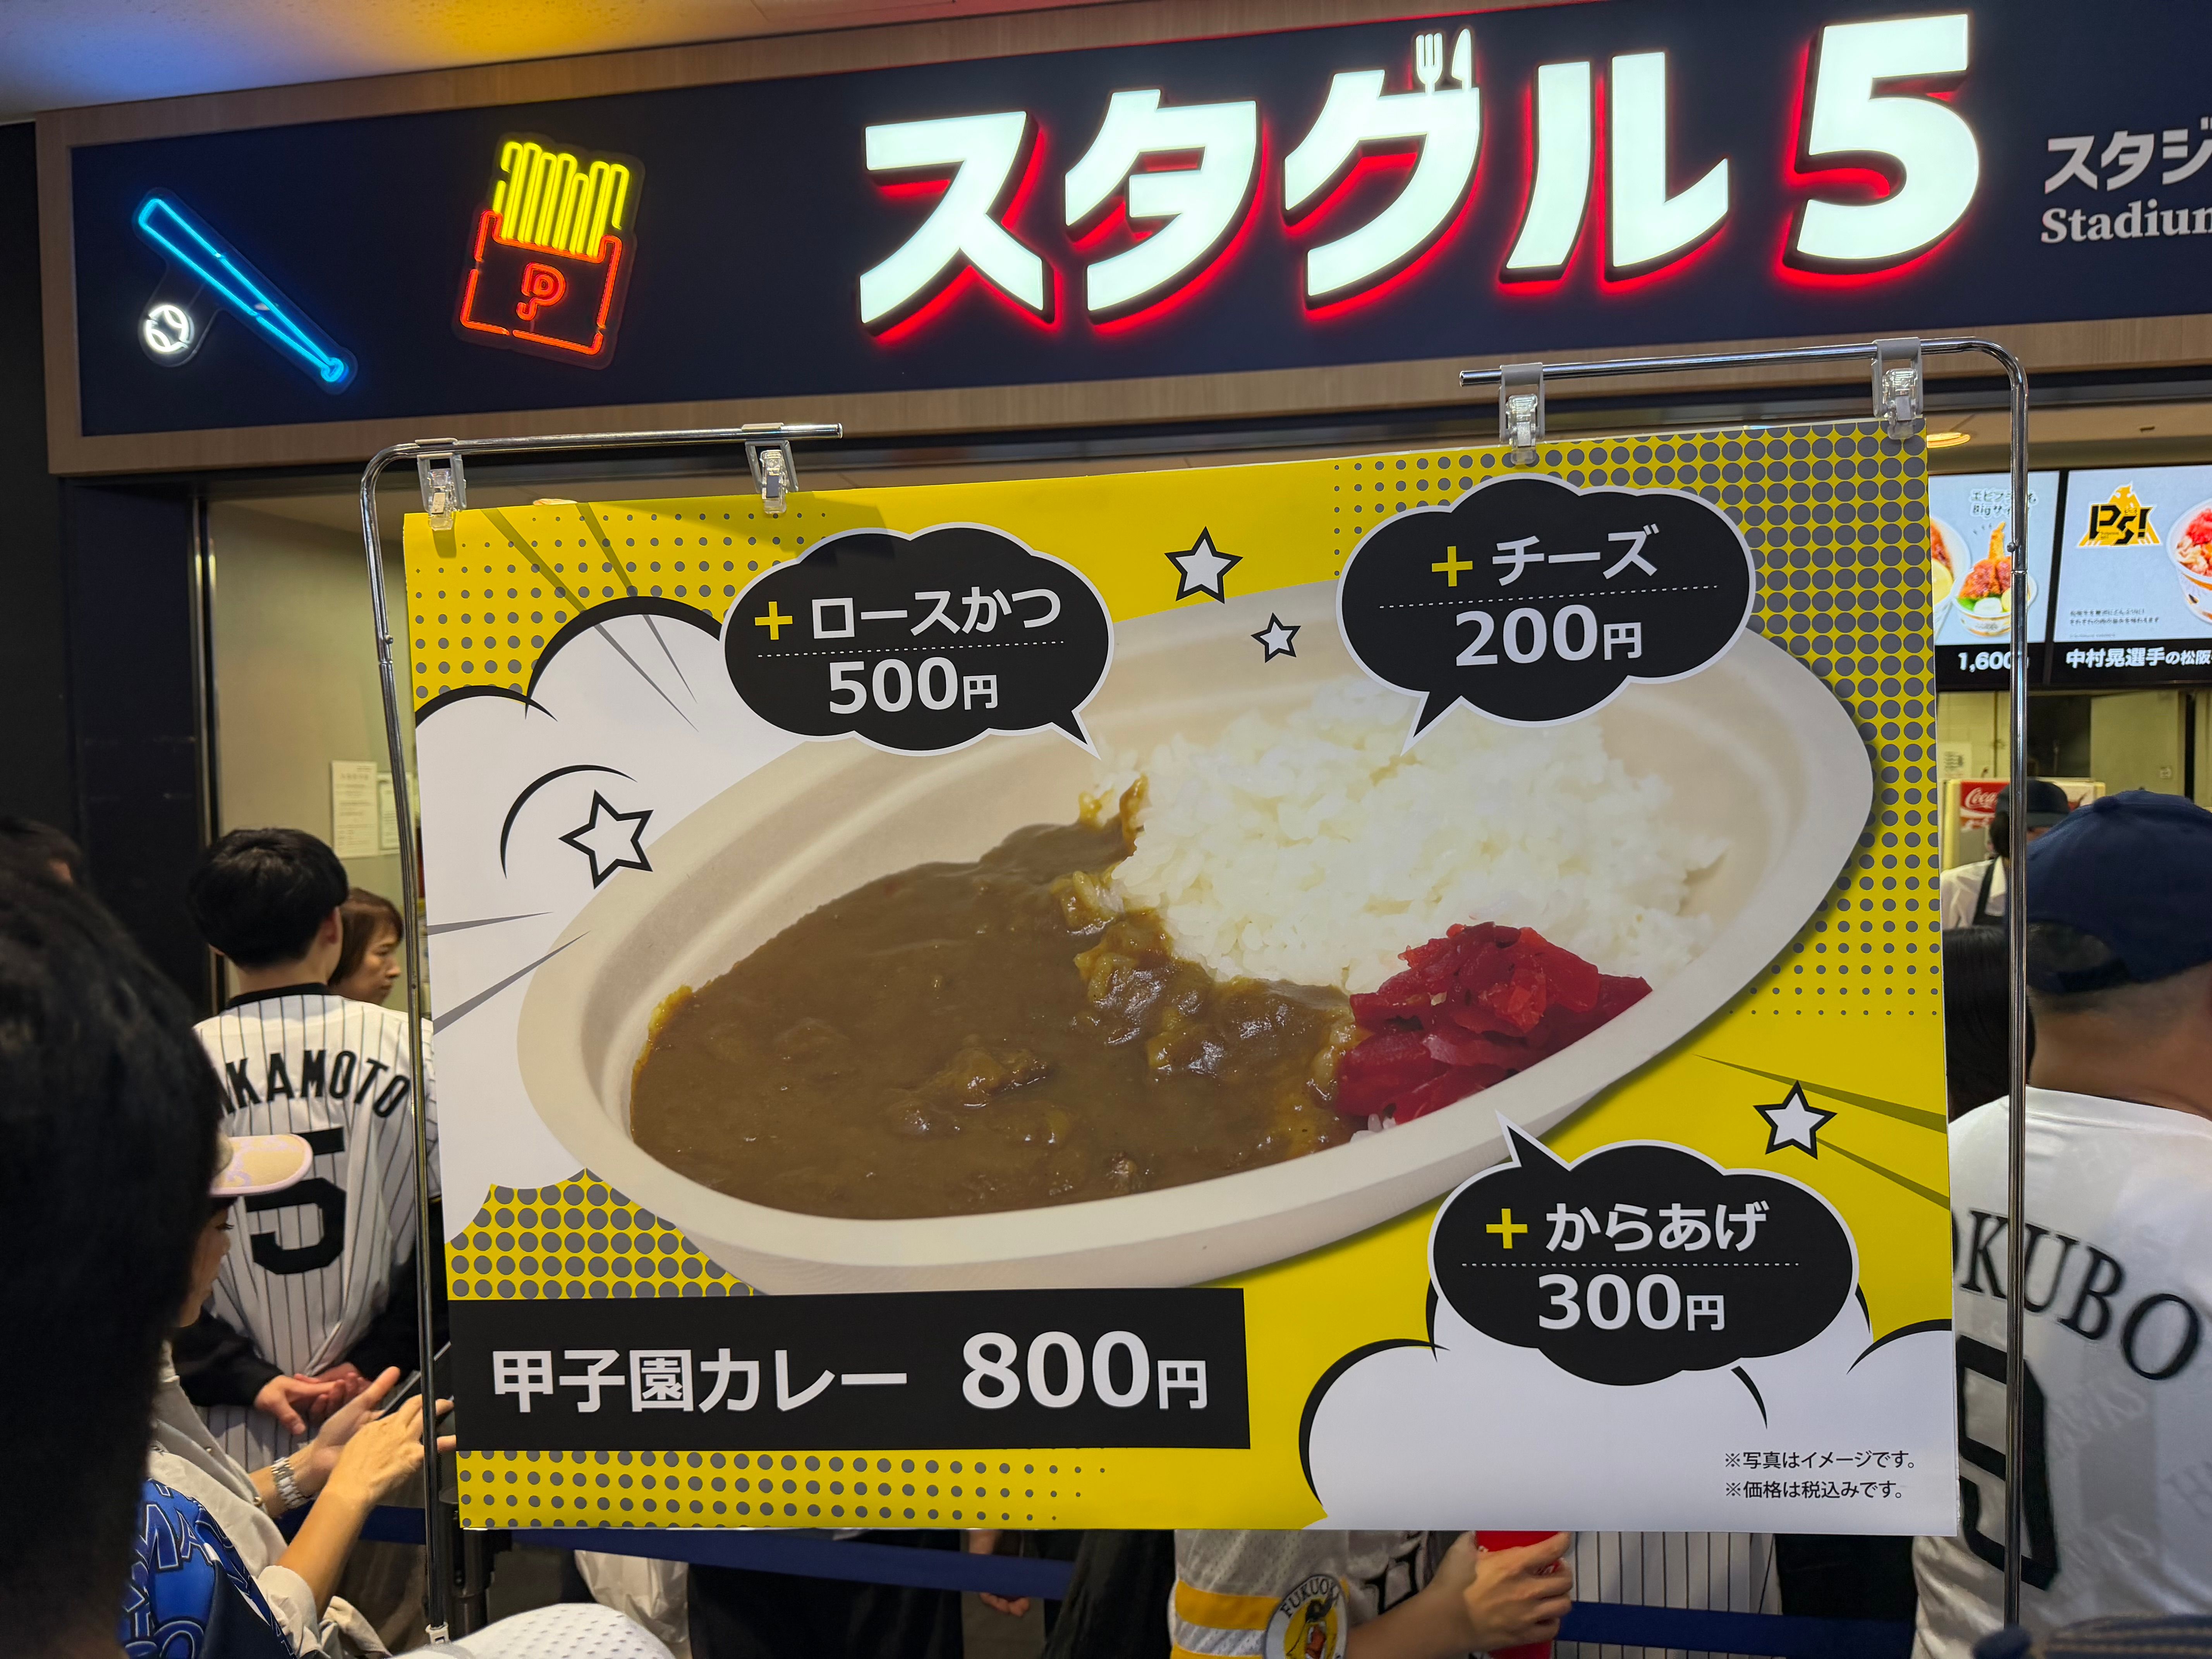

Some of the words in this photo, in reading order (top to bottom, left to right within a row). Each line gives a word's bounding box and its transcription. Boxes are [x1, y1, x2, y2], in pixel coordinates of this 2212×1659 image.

[860, 27, 1729, 325] スタグル
[1793, 13, 1980, 265] 5
[1492, 523, 1659, 587] チーズ
[812, 586, 1061, 639] ロースかつ
[1455, 604, 1642, 666] 200円
[829, 656, 998, 714] 500円
[2066, 646, 2212, 669] 中村晃選手の松阪
[1546, 1200, 1770, 1252] からあげ
[1538, 1273, 1725, 1331] 300円
[1952, 1207, 2201, 1381] KUBO
[492, 1348, 908, 1414] 甲子園カレー
[962, 1329, 1208, 1412] 800円
